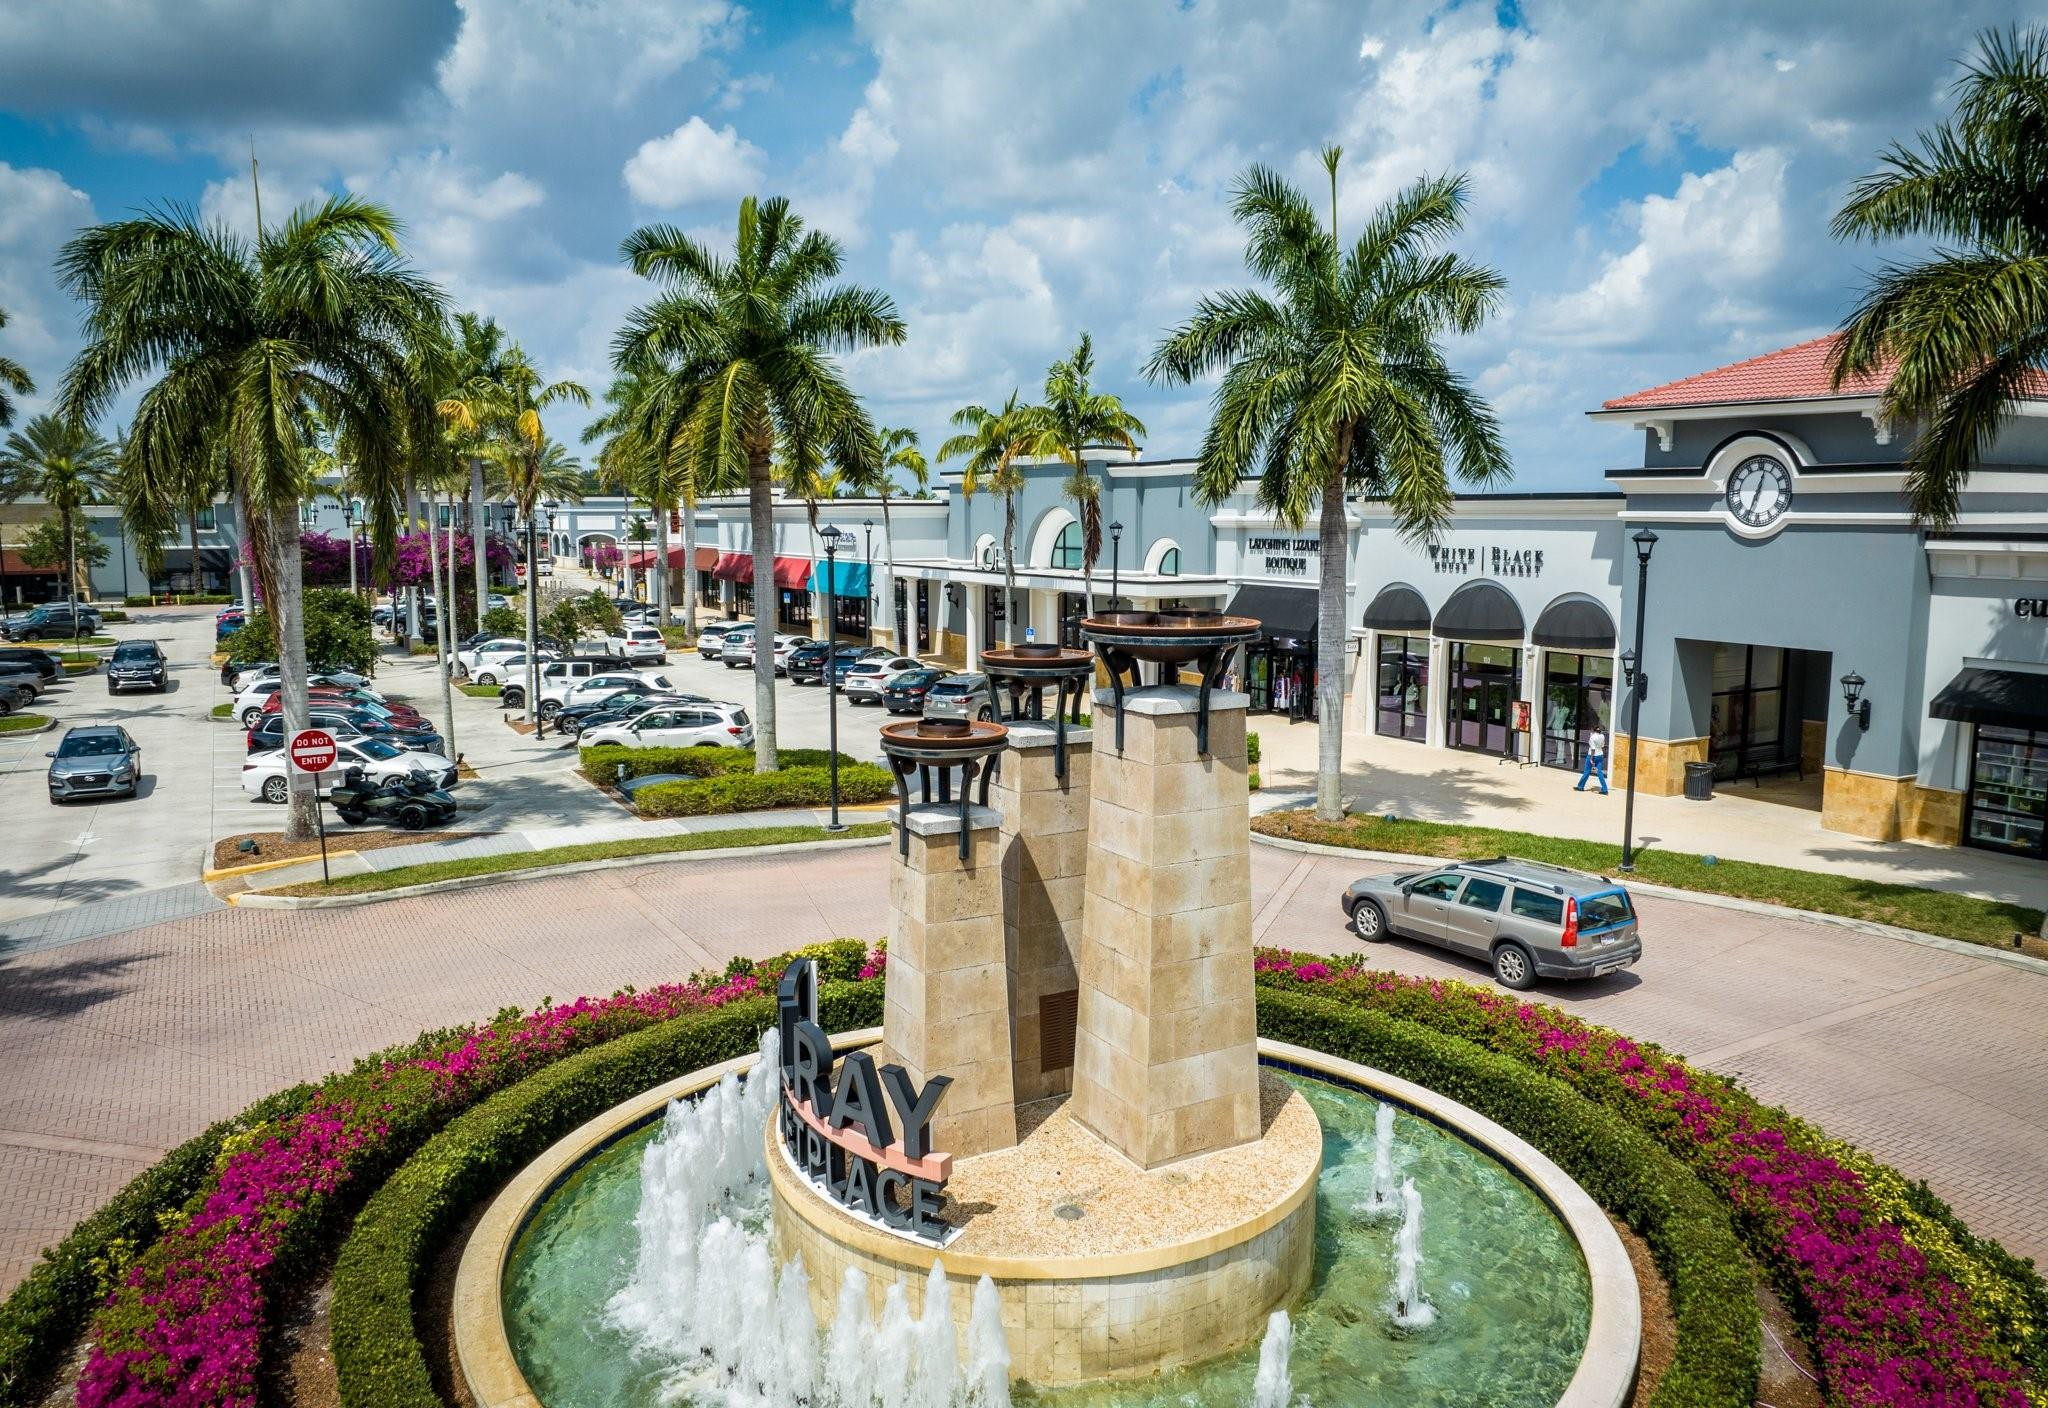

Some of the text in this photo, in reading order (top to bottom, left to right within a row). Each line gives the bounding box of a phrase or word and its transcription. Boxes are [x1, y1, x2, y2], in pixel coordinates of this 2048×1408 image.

[1249, 538, 1290, 550] LAUGHING
[1428, 545, 1543, 563] WHITE BLACK
[1266, 557, 1306, 571] BOUTIQUE
[1434, 562, 1541, 575] HOUSE MARKET
[302, 756, 327, 765] ENTER
